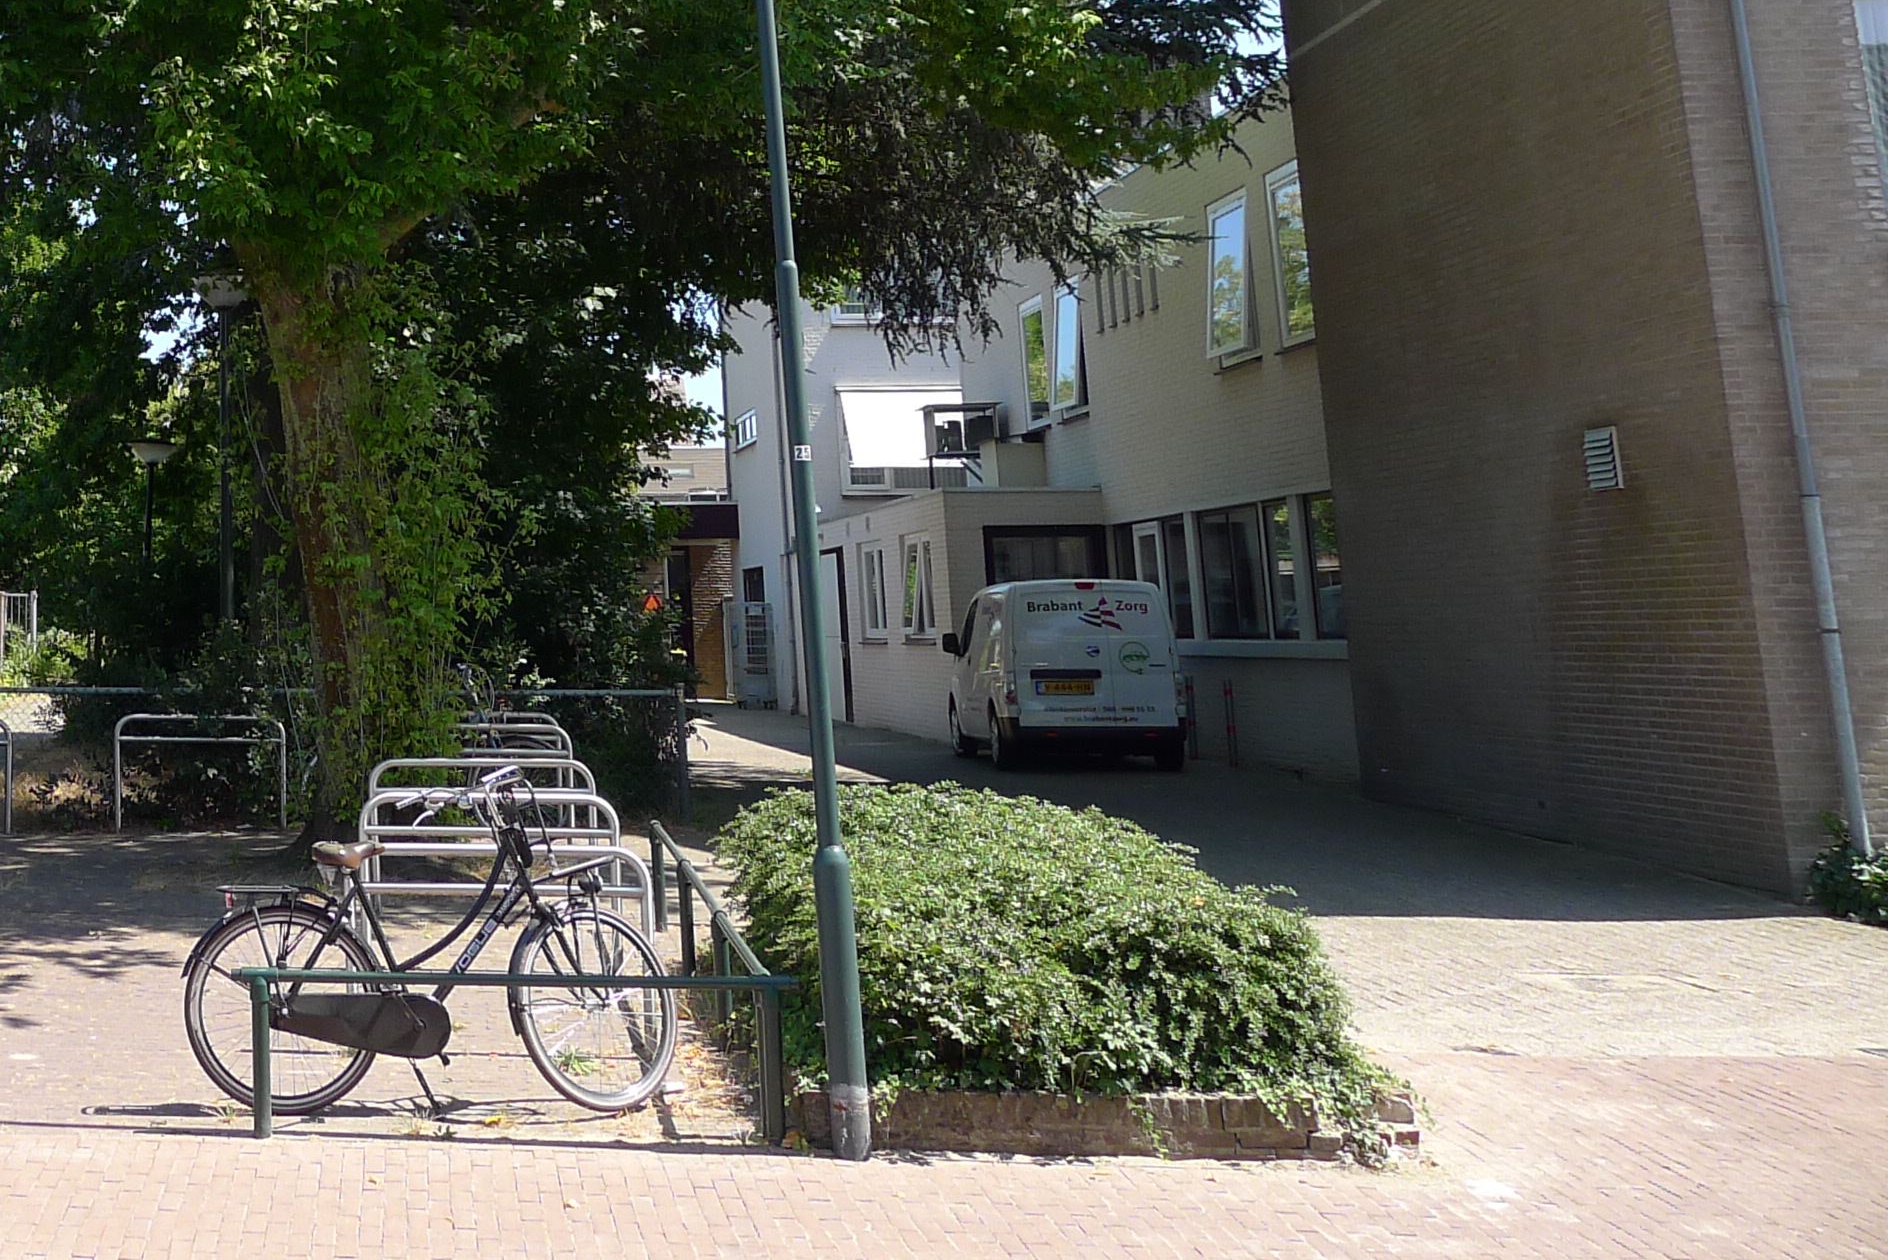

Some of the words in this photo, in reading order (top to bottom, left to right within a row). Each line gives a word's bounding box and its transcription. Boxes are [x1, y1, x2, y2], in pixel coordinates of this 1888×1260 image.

[796, 447, 809, 459] 25
[1026, 600, 1083, 612] Brabant
[1115, 600, 1148, 614] Zorg
